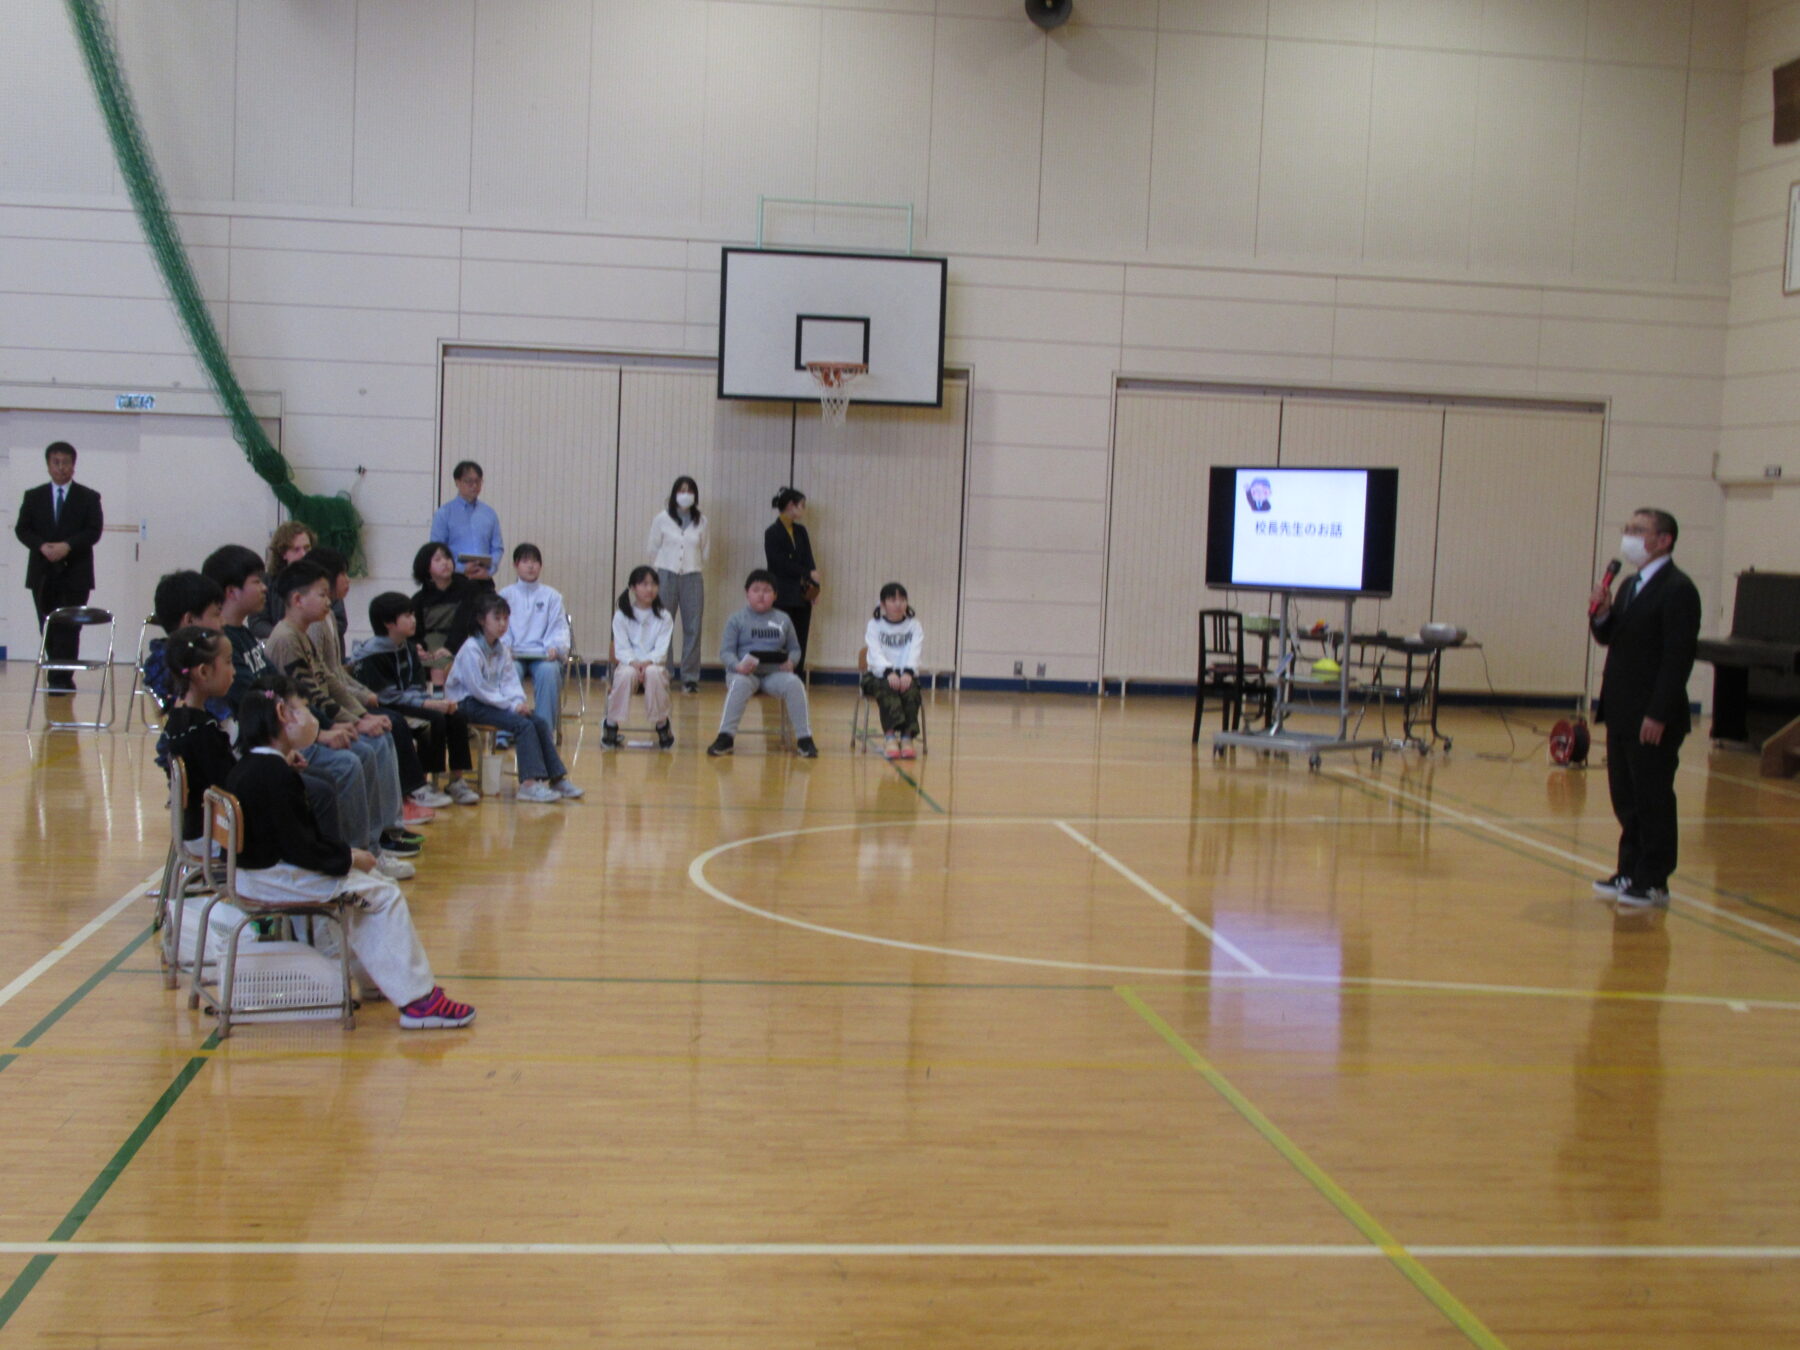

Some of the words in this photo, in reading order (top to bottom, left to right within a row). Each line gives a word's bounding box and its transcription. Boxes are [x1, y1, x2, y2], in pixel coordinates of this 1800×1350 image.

[1255, 519, 1343, 538] 校長先生のお話
[751, 628, 780, 639] PUMA
